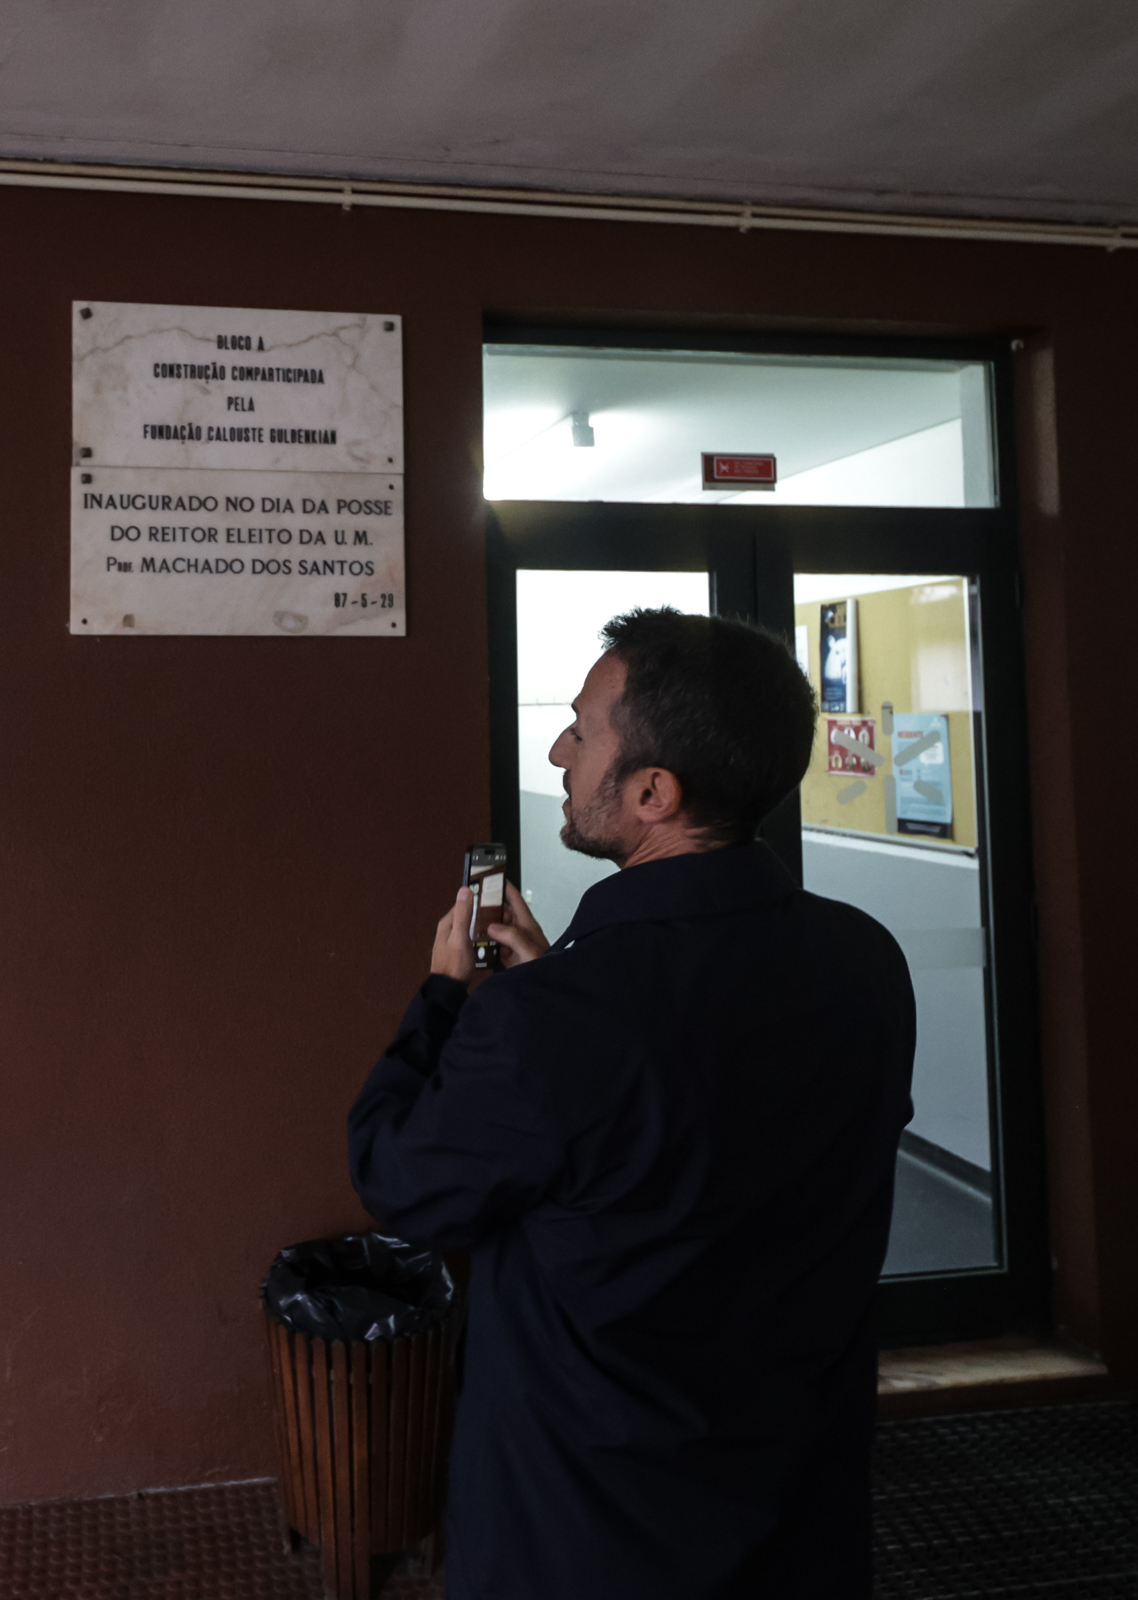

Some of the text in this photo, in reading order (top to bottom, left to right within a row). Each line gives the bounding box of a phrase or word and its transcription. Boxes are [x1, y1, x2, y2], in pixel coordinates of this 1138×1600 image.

[216, 334, 265, 352] BLOCO A
[153, 361, 325, 385] CONSTRUÇÃO COMPARTICIPADA
[227, 396, 255, 412] PELA
[143, 422, 337, 445] FUNDAÇÃO CALOUSTE GULBENKIAN
[83, 493, 393, 516] INAUGURADO NO DIA DA POSSE
[110, 525, 141, 543] DO
[148, 526, 218, 544] REITOR
[226, 528, 292, 545] ELEITO
[299, 529, 326, 546] DA
[140, 557, 245, 575] MACHADO
[252, 558, 293, 576] DOS
[298, 559, 375, 577] SANTOS
